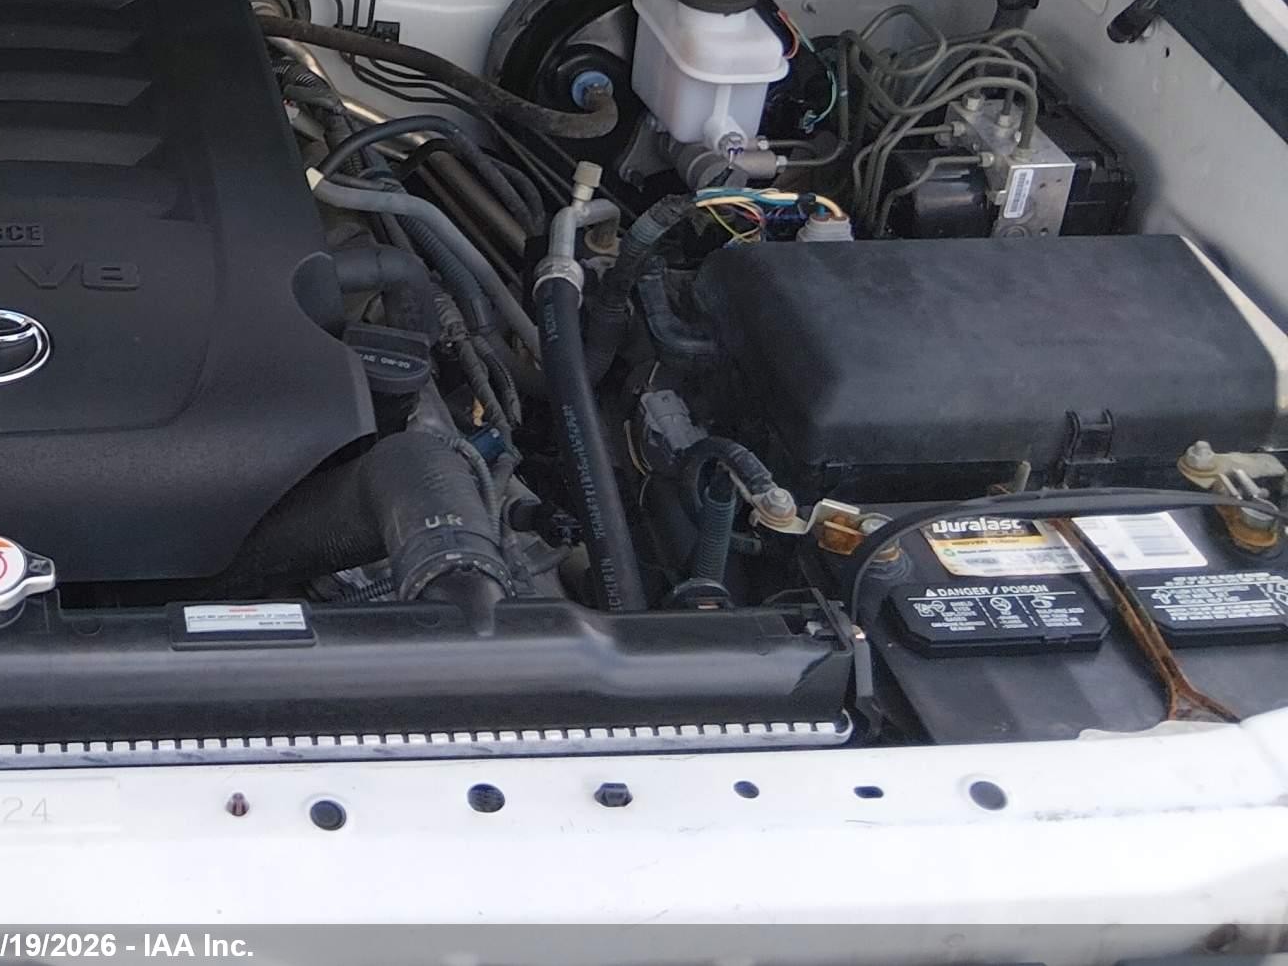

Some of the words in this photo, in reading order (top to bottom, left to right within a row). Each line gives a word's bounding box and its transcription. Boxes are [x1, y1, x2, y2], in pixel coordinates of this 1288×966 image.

[16, 257, 140, 292] V8
[931, 517, 1023, 534] Duralast
[936, 586, 991, 597] DANGER
[1000, 584, 1049, 594] POISON
